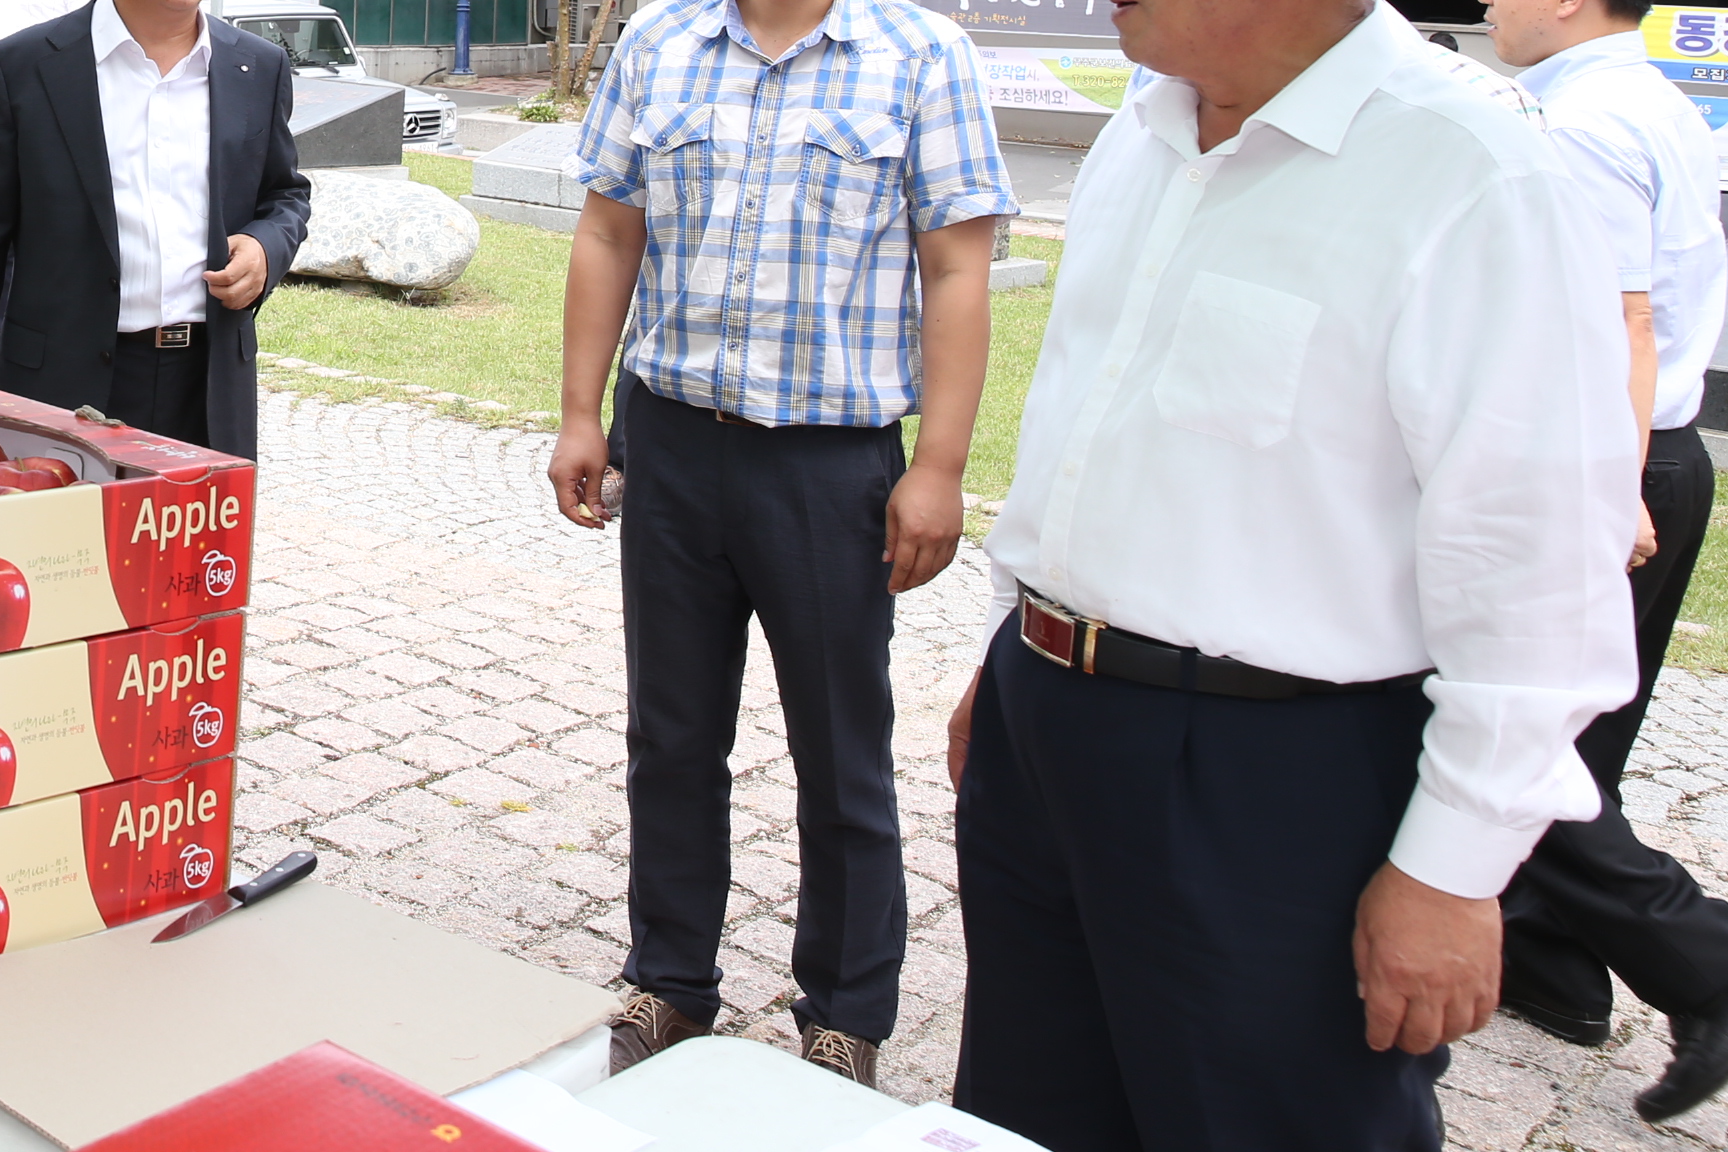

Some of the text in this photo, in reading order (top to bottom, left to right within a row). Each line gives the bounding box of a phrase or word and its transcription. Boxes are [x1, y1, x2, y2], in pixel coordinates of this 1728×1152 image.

[130, 485, 240, 552] Apple
[165, 568, 233, 597] 사과 5kg
[117, 638, 227, 707] Apple
[152, 719, 219, 749] 사과 5kg
[109, 781, 217, 852] Apple
[143, 861, 210, 893] 사과 5kg
